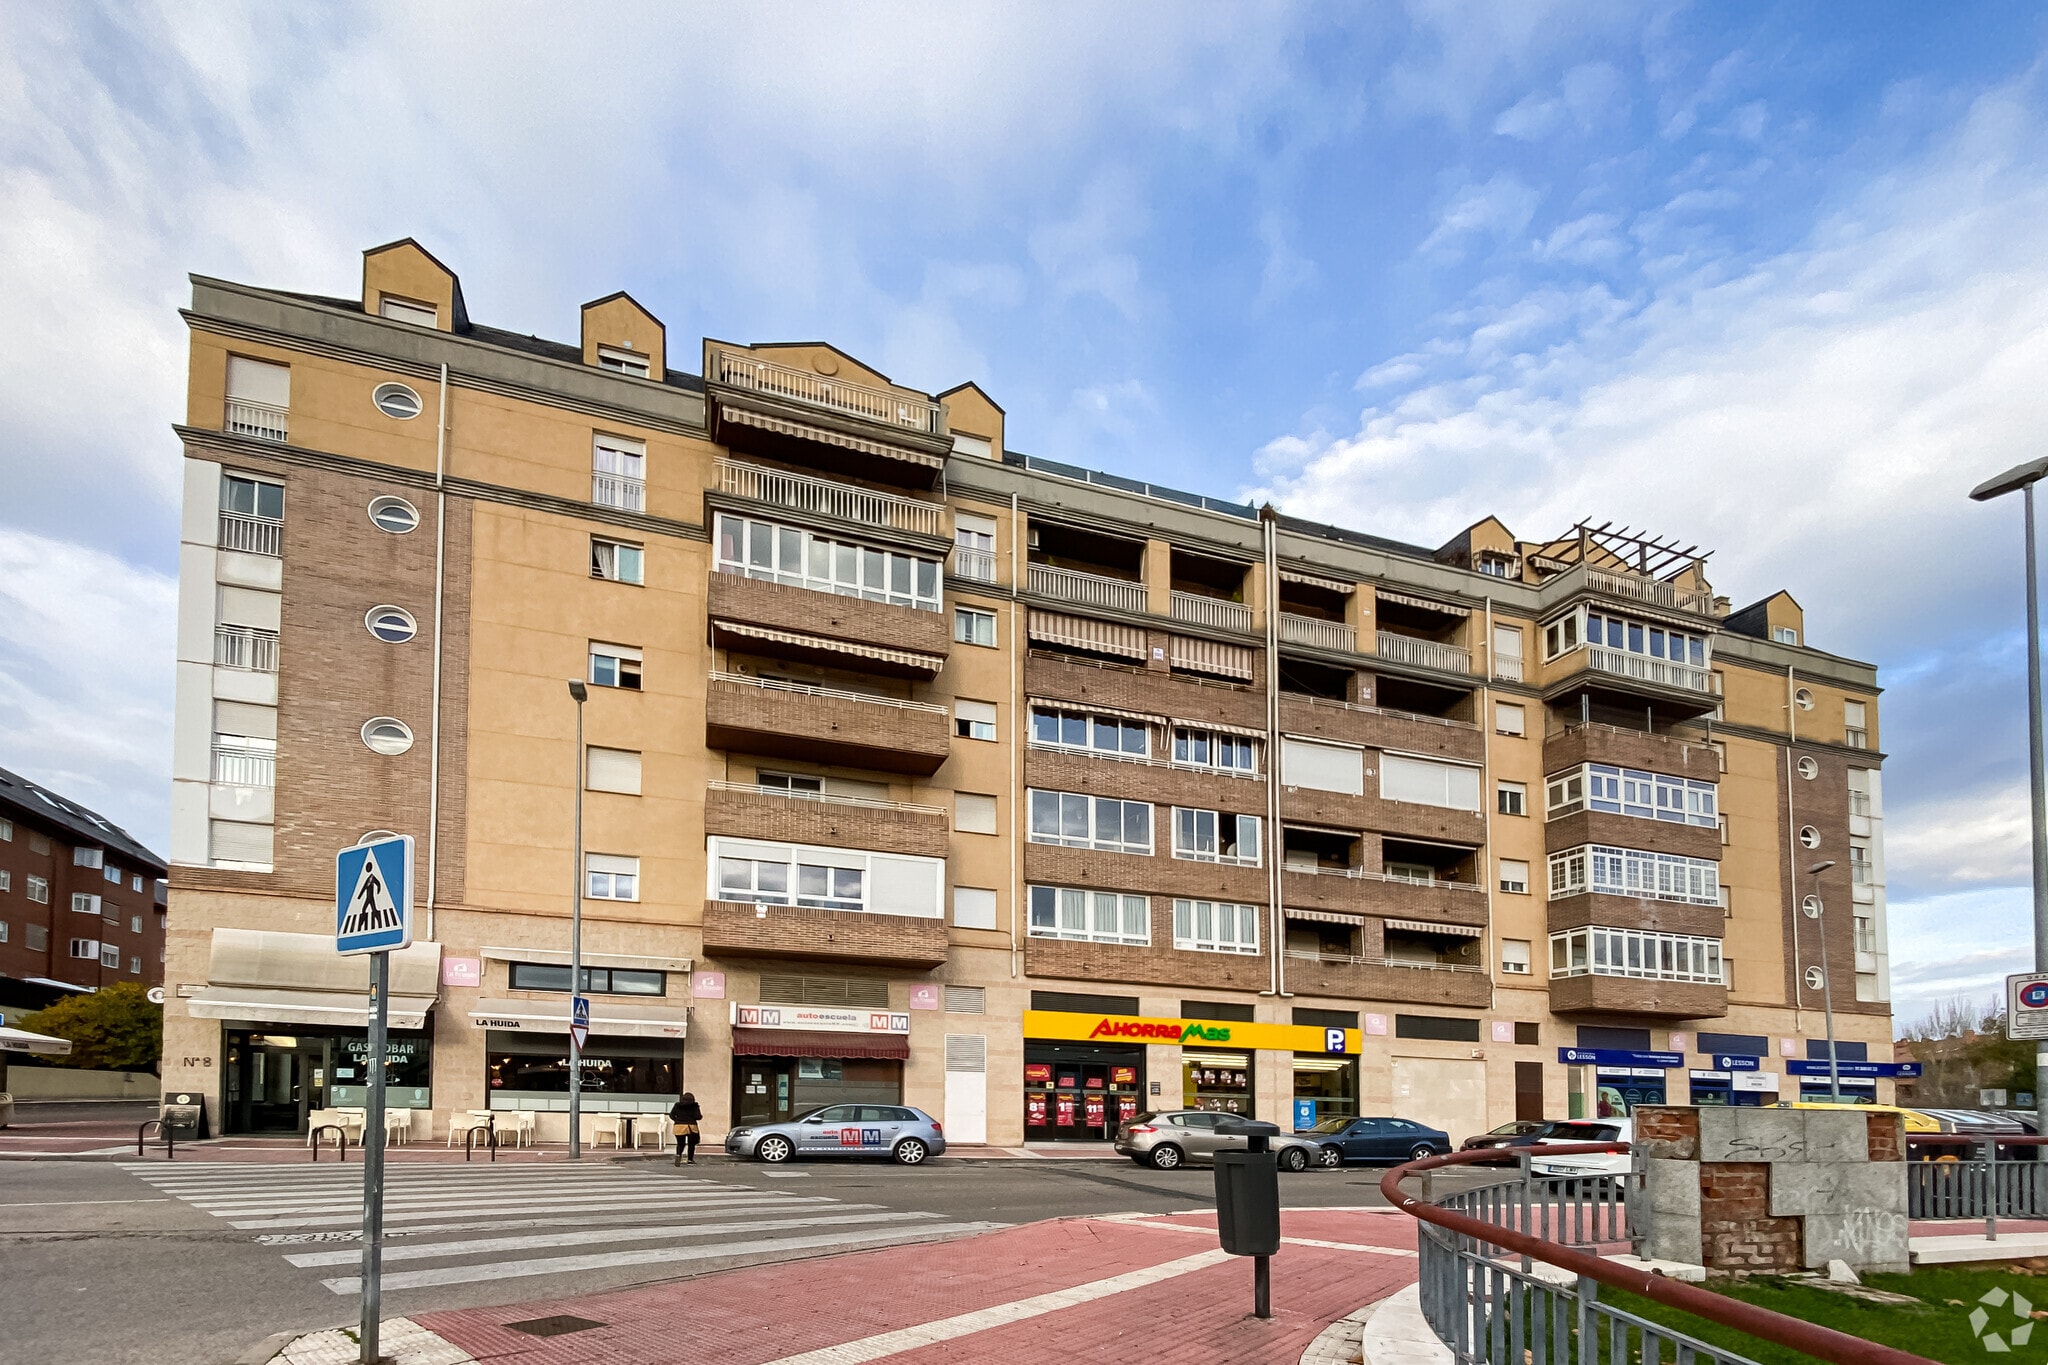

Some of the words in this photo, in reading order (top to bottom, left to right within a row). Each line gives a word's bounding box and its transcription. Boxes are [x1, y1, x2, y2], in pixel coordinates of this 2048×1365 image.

[796, 1011, 857, 1021] autoescuela
[490, 1020, 520, 1028] HUIDA
[1327, 1029, 1345, 1051] P
[203, 1056, 212, 1067] 8
[353, 1054, 368, 1062] LA
[578, 1059, 612, 1067] HUIDA
[1731, 1059, 1755, 1067] LESSON
[863, 1129, 880, 1143] M
